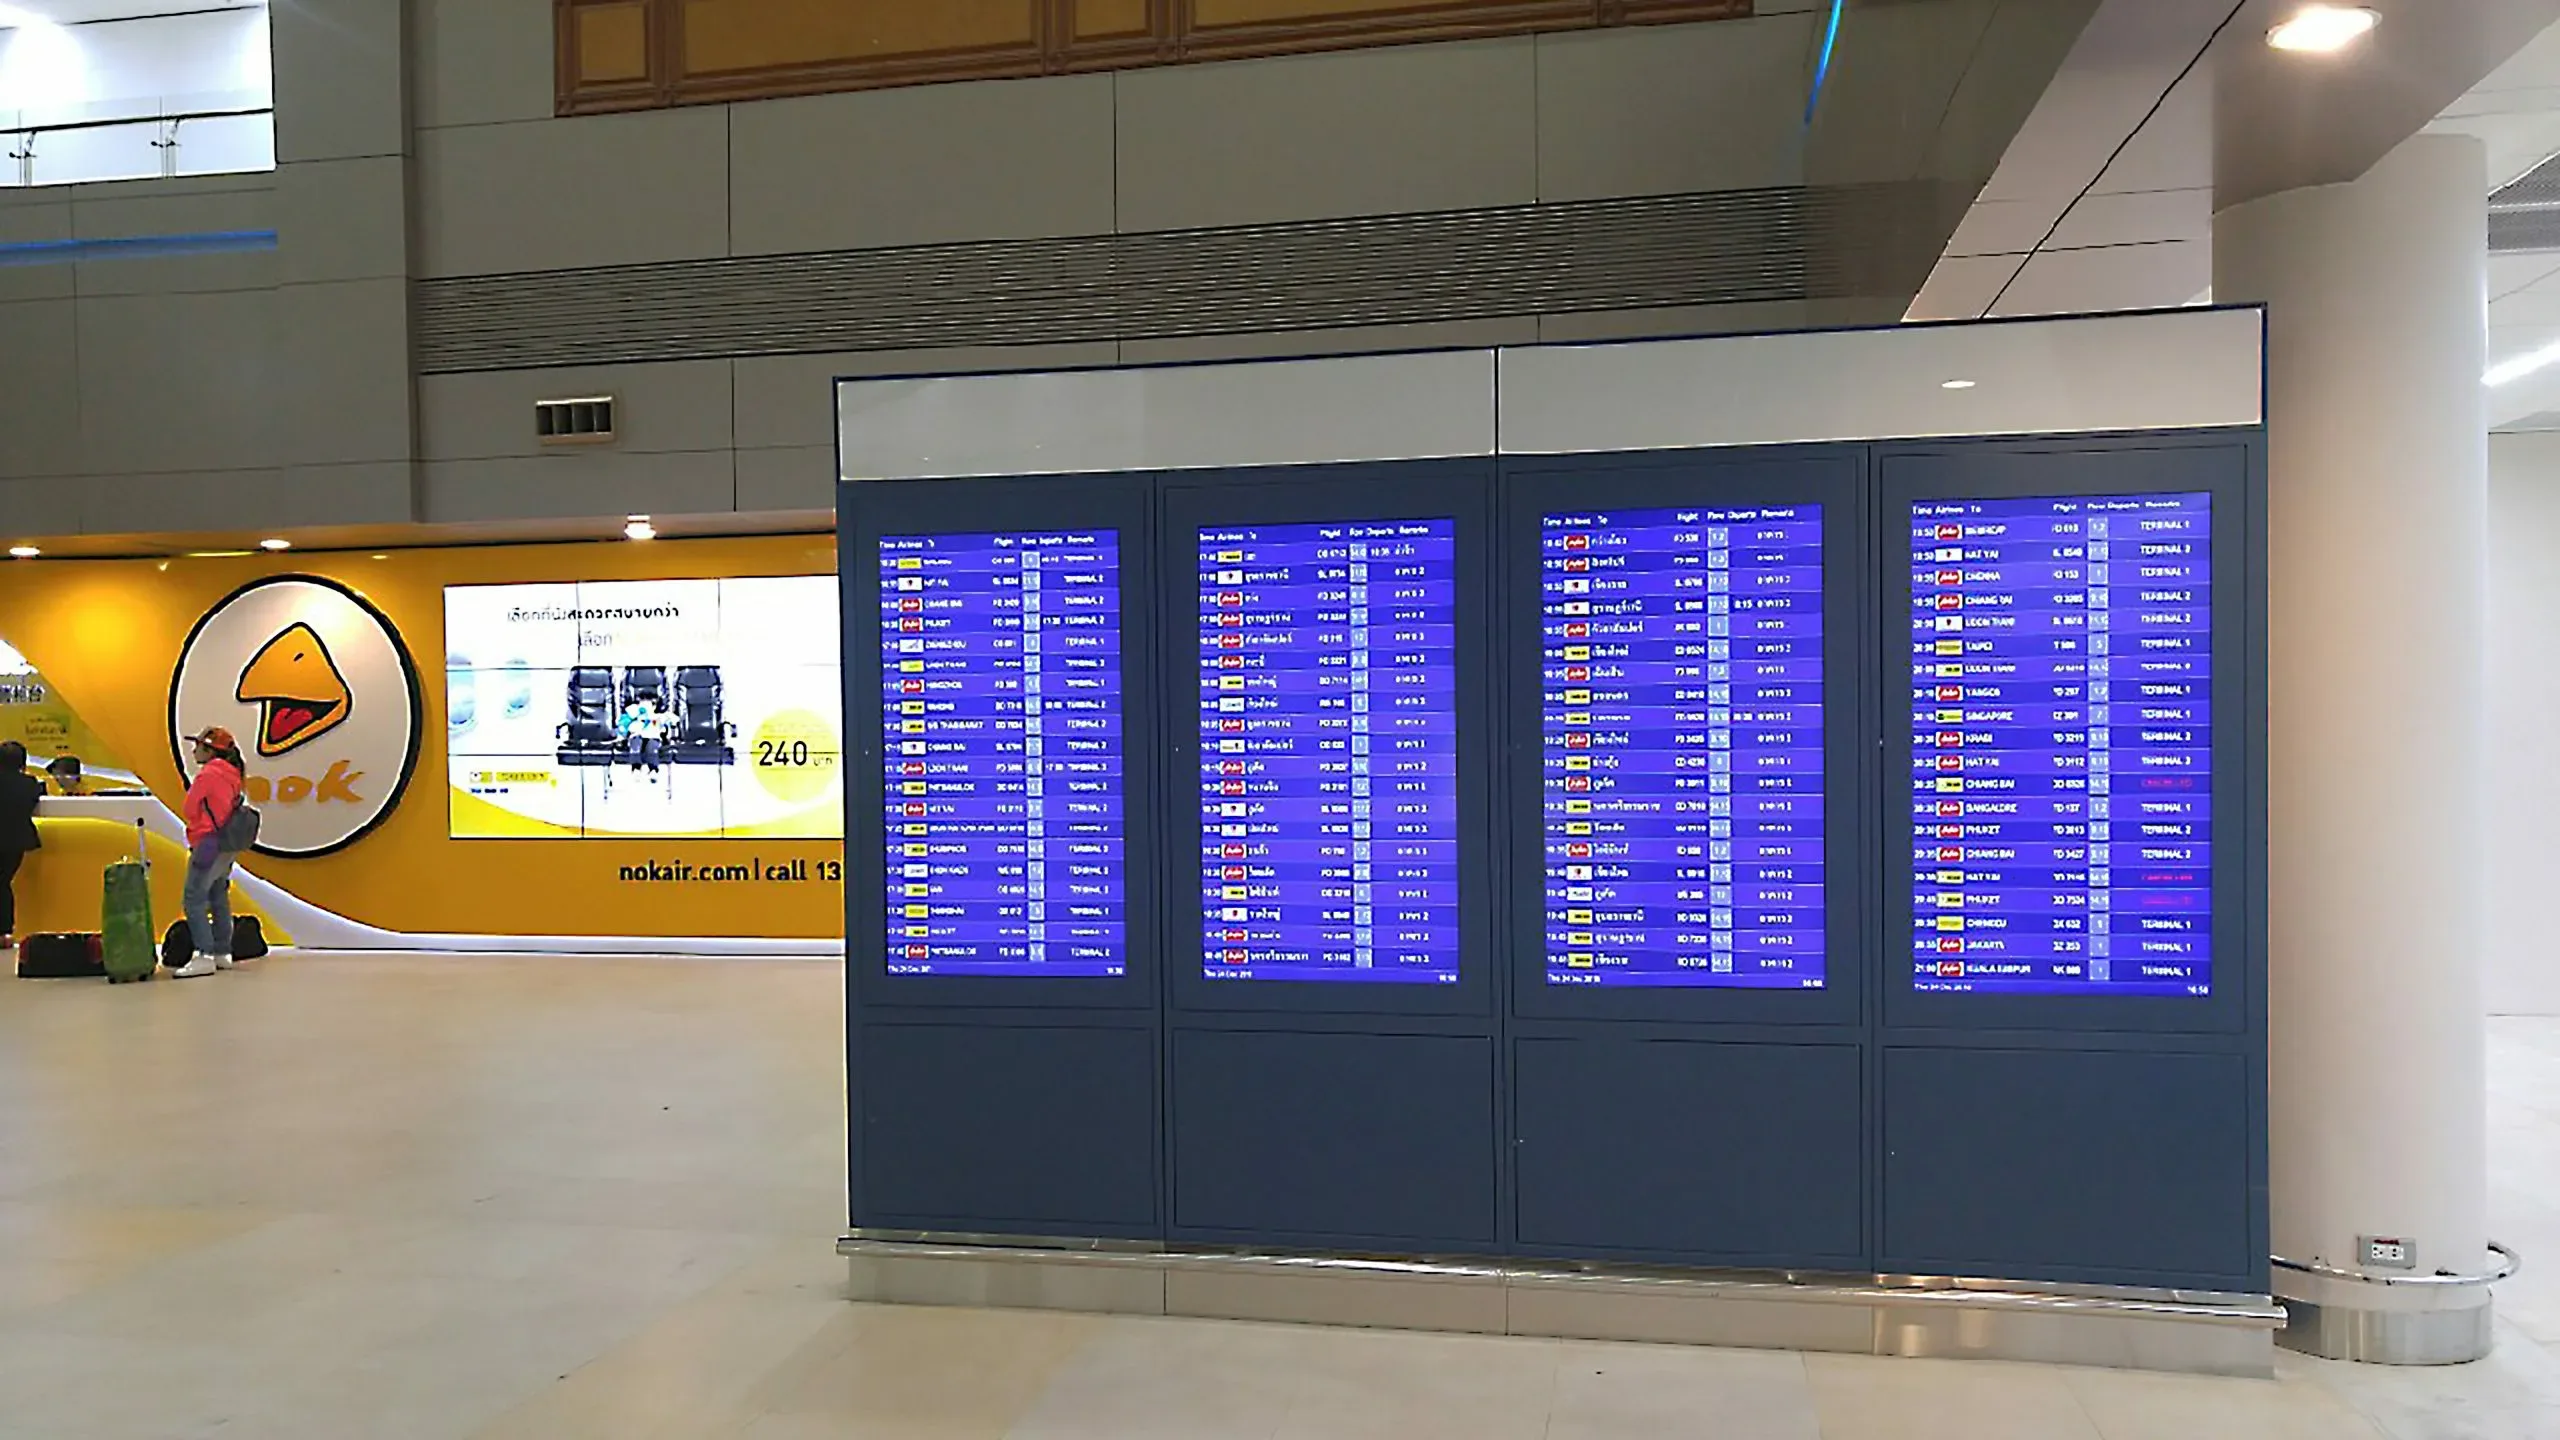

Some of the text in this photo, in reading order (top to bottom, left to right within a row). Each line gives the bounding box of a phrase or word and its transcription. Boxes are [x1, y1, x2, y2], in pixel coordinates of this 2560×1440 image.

[759, 740, 808, 766] 240
[619, 859, 749, 881] nokair.com
[765, 859, 807, 881] call
